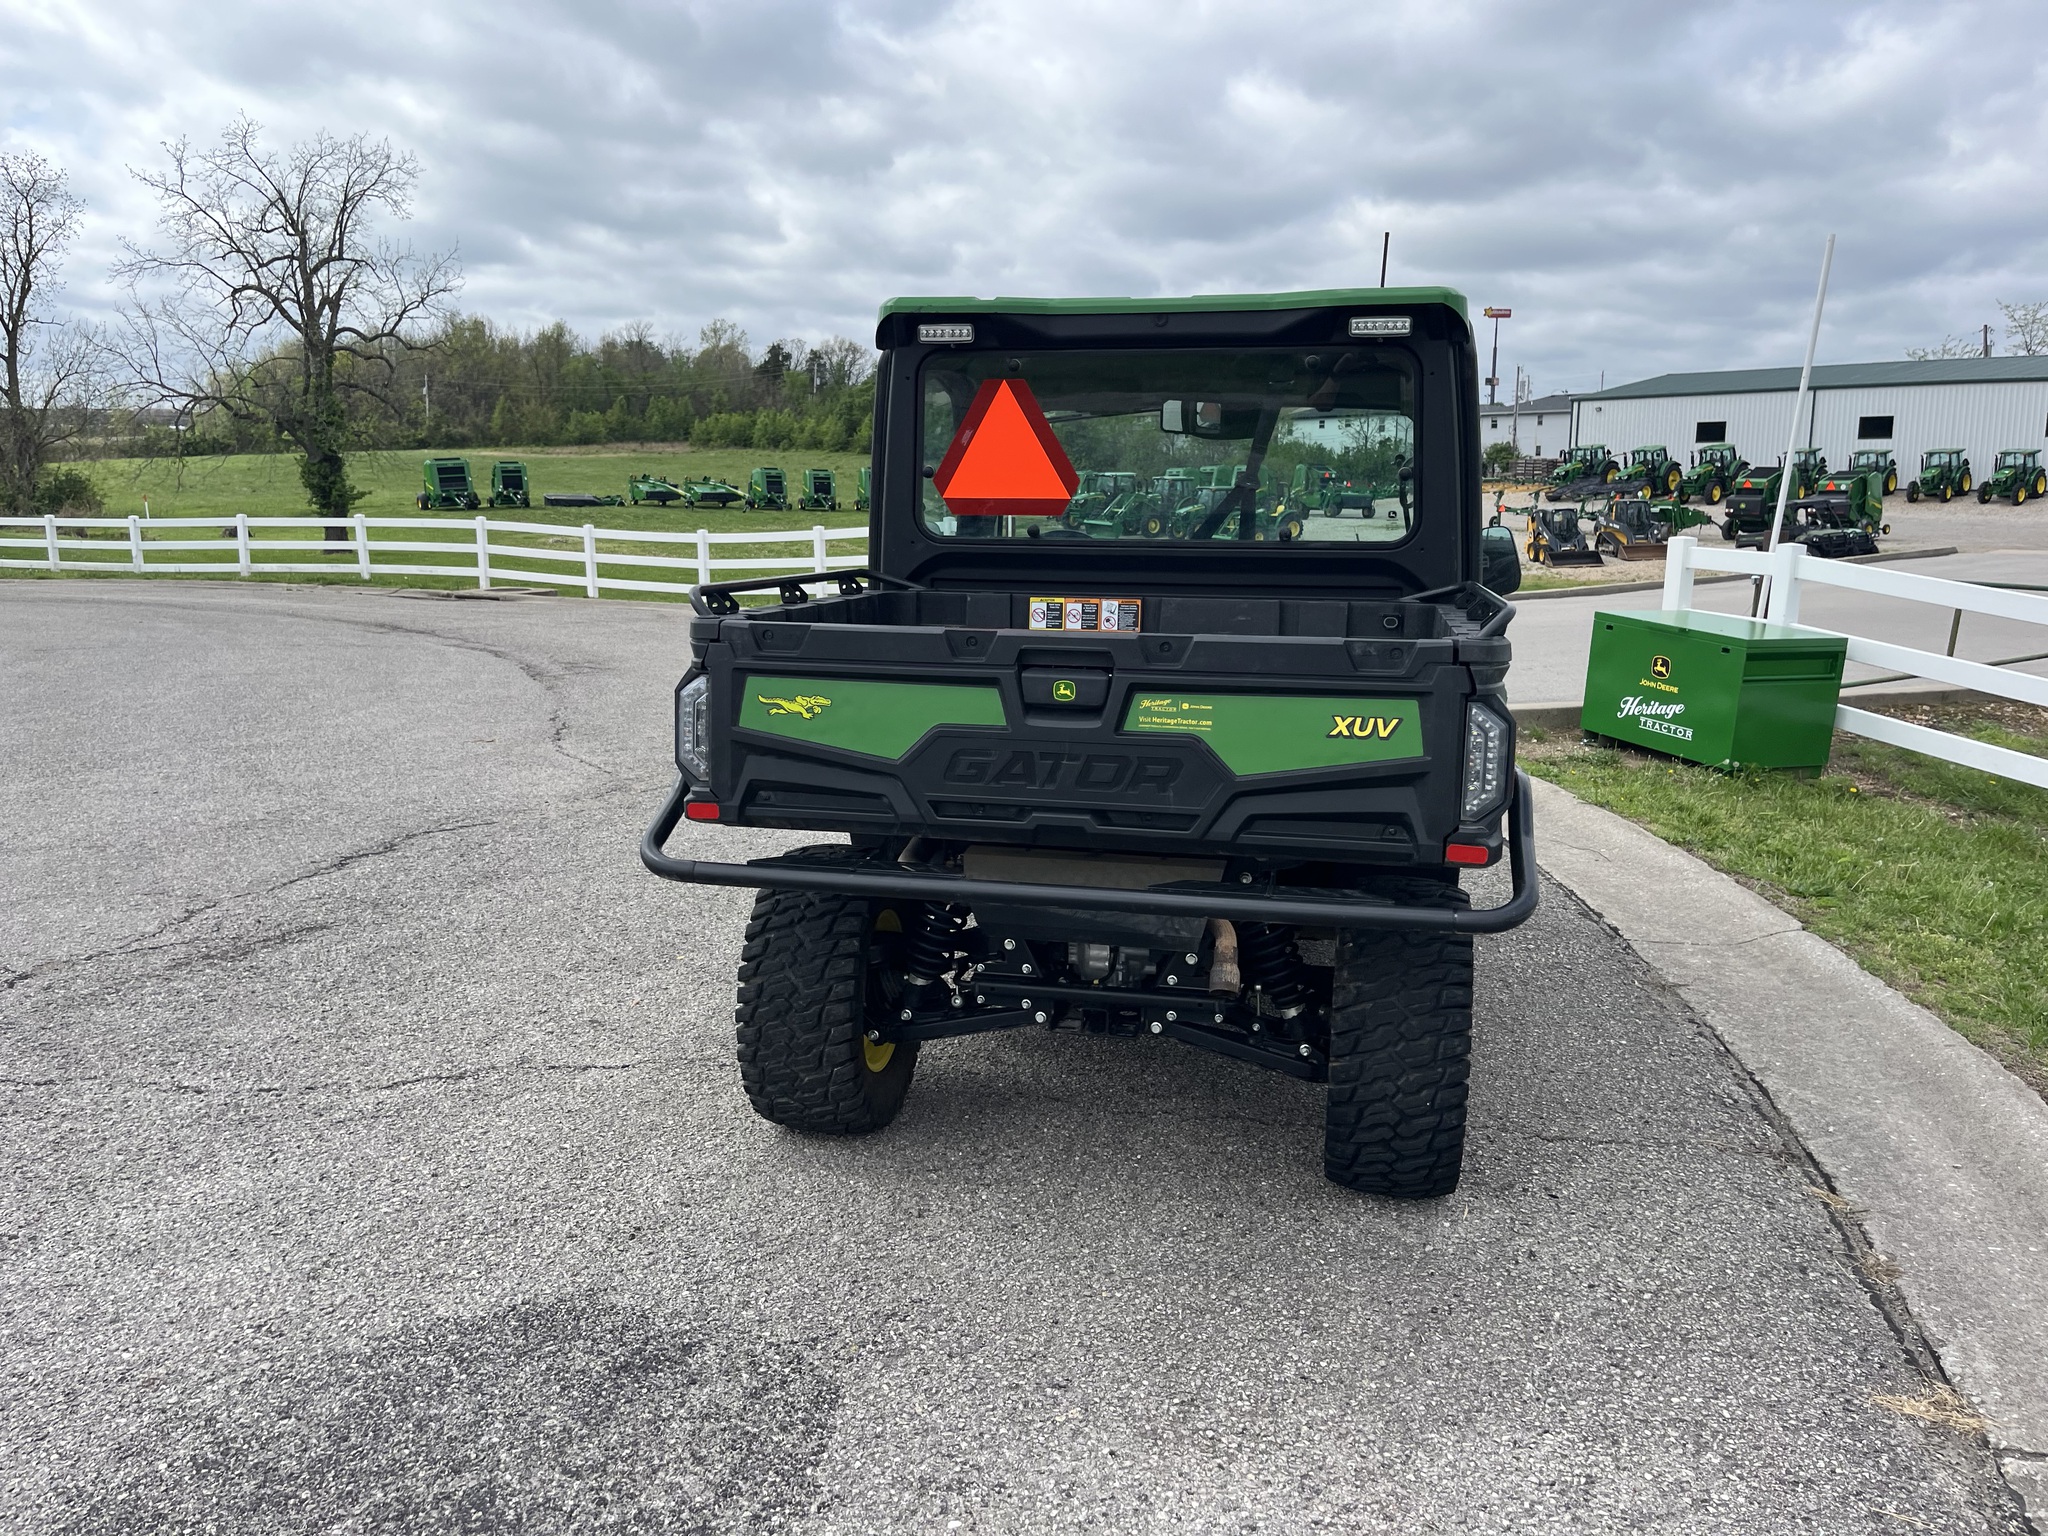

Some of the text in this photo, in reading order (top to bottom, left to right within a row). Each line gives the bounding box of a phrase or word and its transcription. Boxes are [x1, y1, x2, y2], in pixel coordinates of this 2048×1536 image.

[1639, 678, 1679, 693] JOHN DEERE
[1139, 699, 1171, 709] Heritage
[1617, 696, 1685, 719] Heritage
[1152, 717, 1212, 725] HeritageTractor.com
[1326, 715, 1403, 740] XUV
[1639, 717, 1693, 740] TRACTOR
[943, 748, 1184, 794] GATOR
